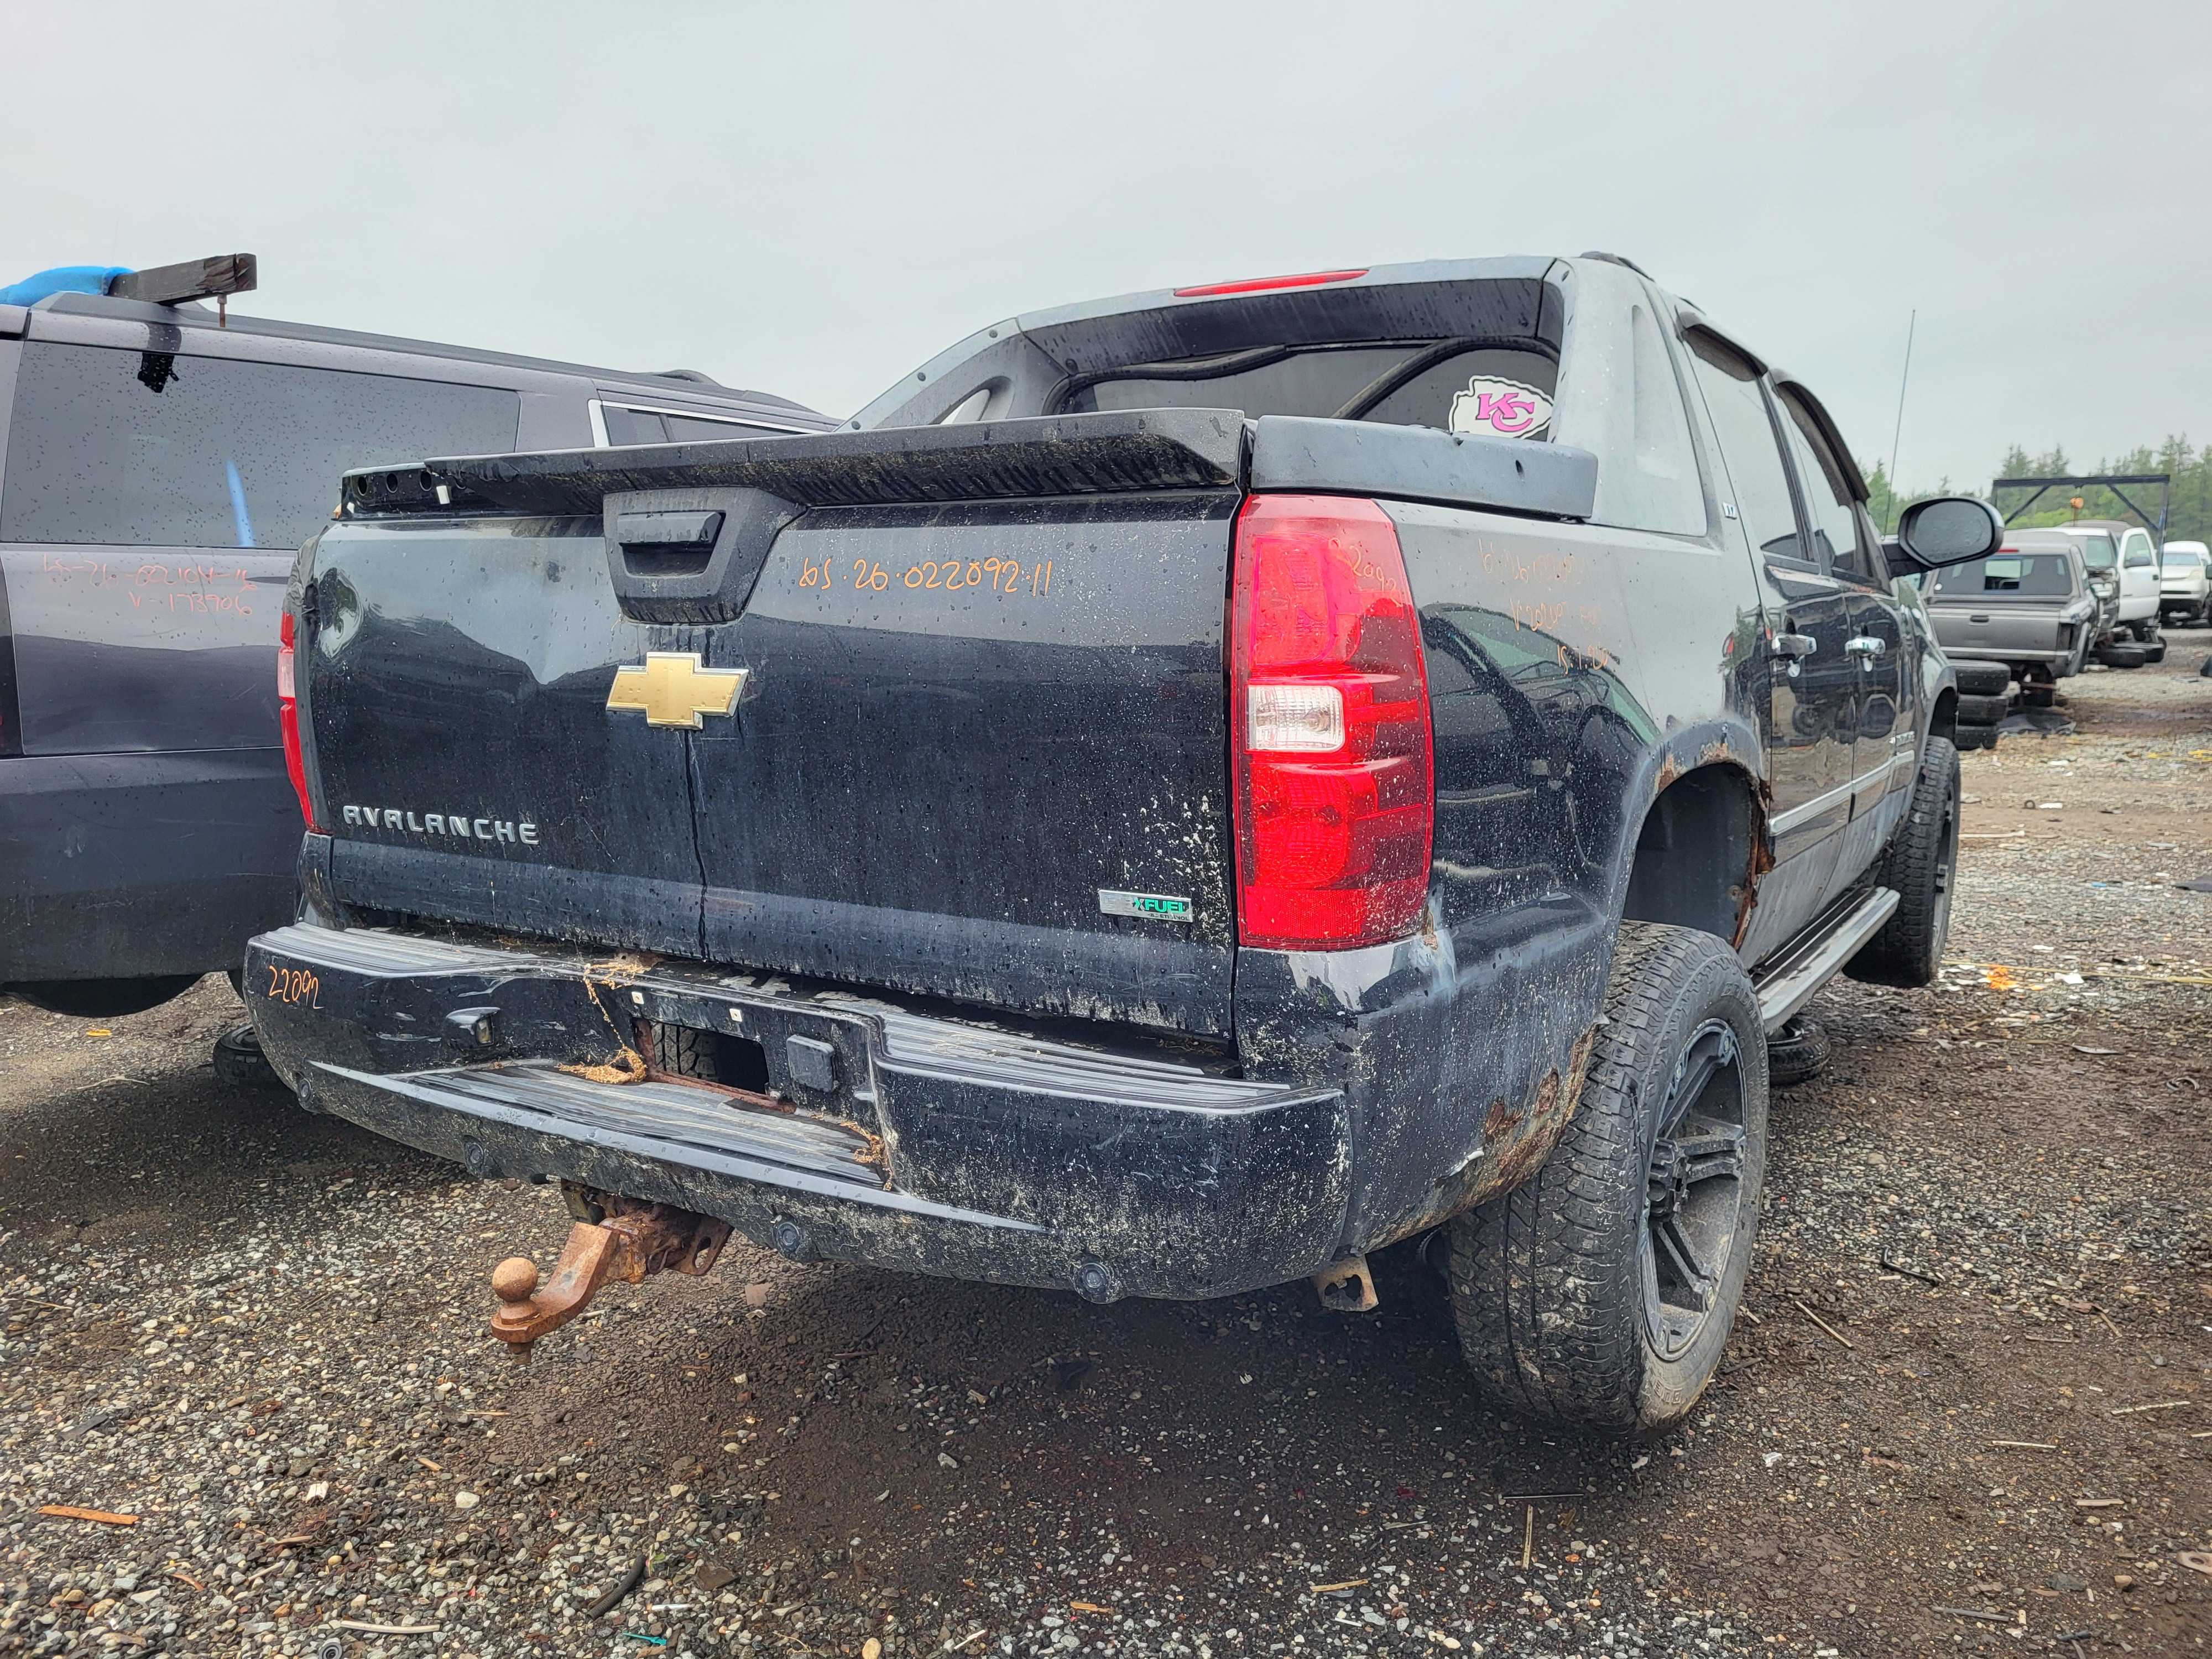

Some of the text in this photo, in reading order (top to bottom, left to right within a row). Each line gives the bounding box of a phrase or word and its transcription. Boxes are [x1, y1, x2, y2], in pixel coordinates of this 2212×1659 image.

[1475, 393, 1535, 432] KC
[343, 805, 540, 845] AVALANCHE
[269, 965, 325, 1009] 22092
